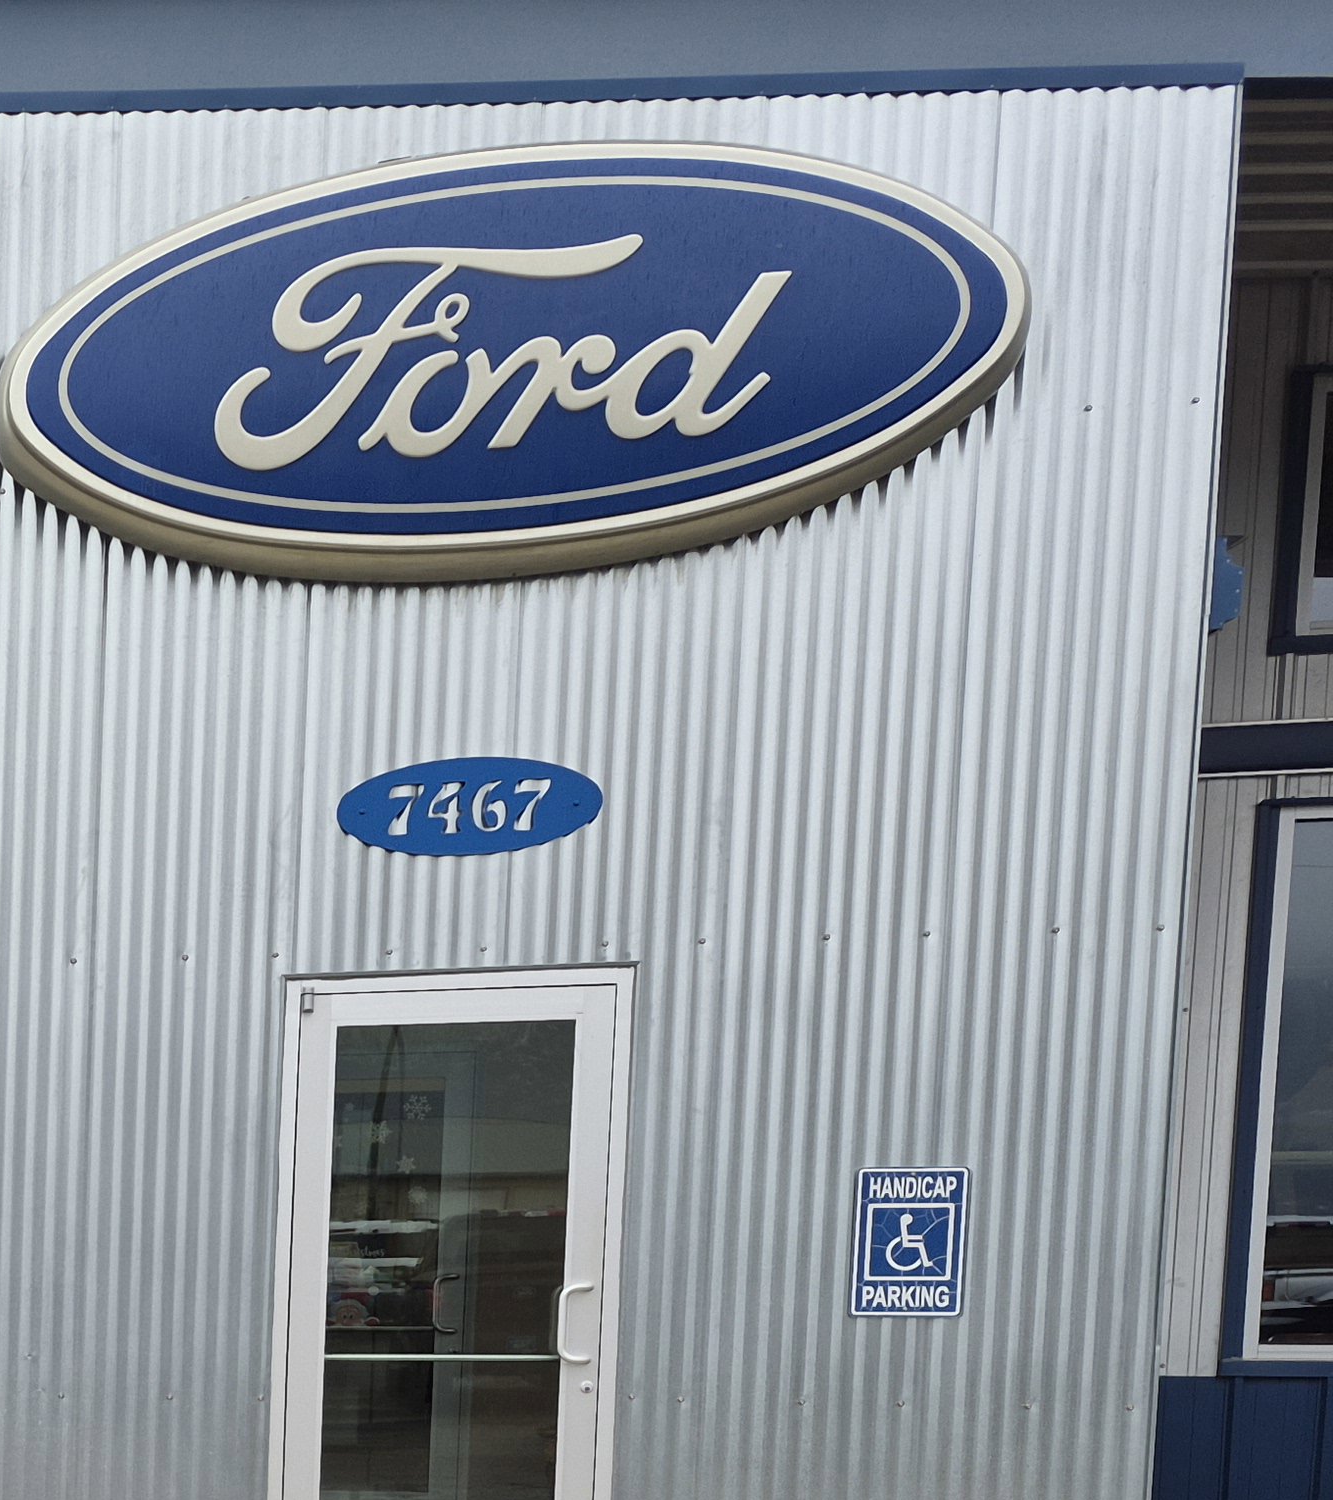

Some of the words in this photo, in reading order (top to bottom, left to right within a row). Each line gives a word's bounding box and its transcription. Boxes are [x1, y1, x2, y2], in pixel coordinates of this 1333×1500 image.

[213, 232, 792, 471] Ford
[386, 778, 553, 836] 7467
[868, 1176, 958, 1199] HANDICAP
[861, 1285, 951, 1308] PARKING
